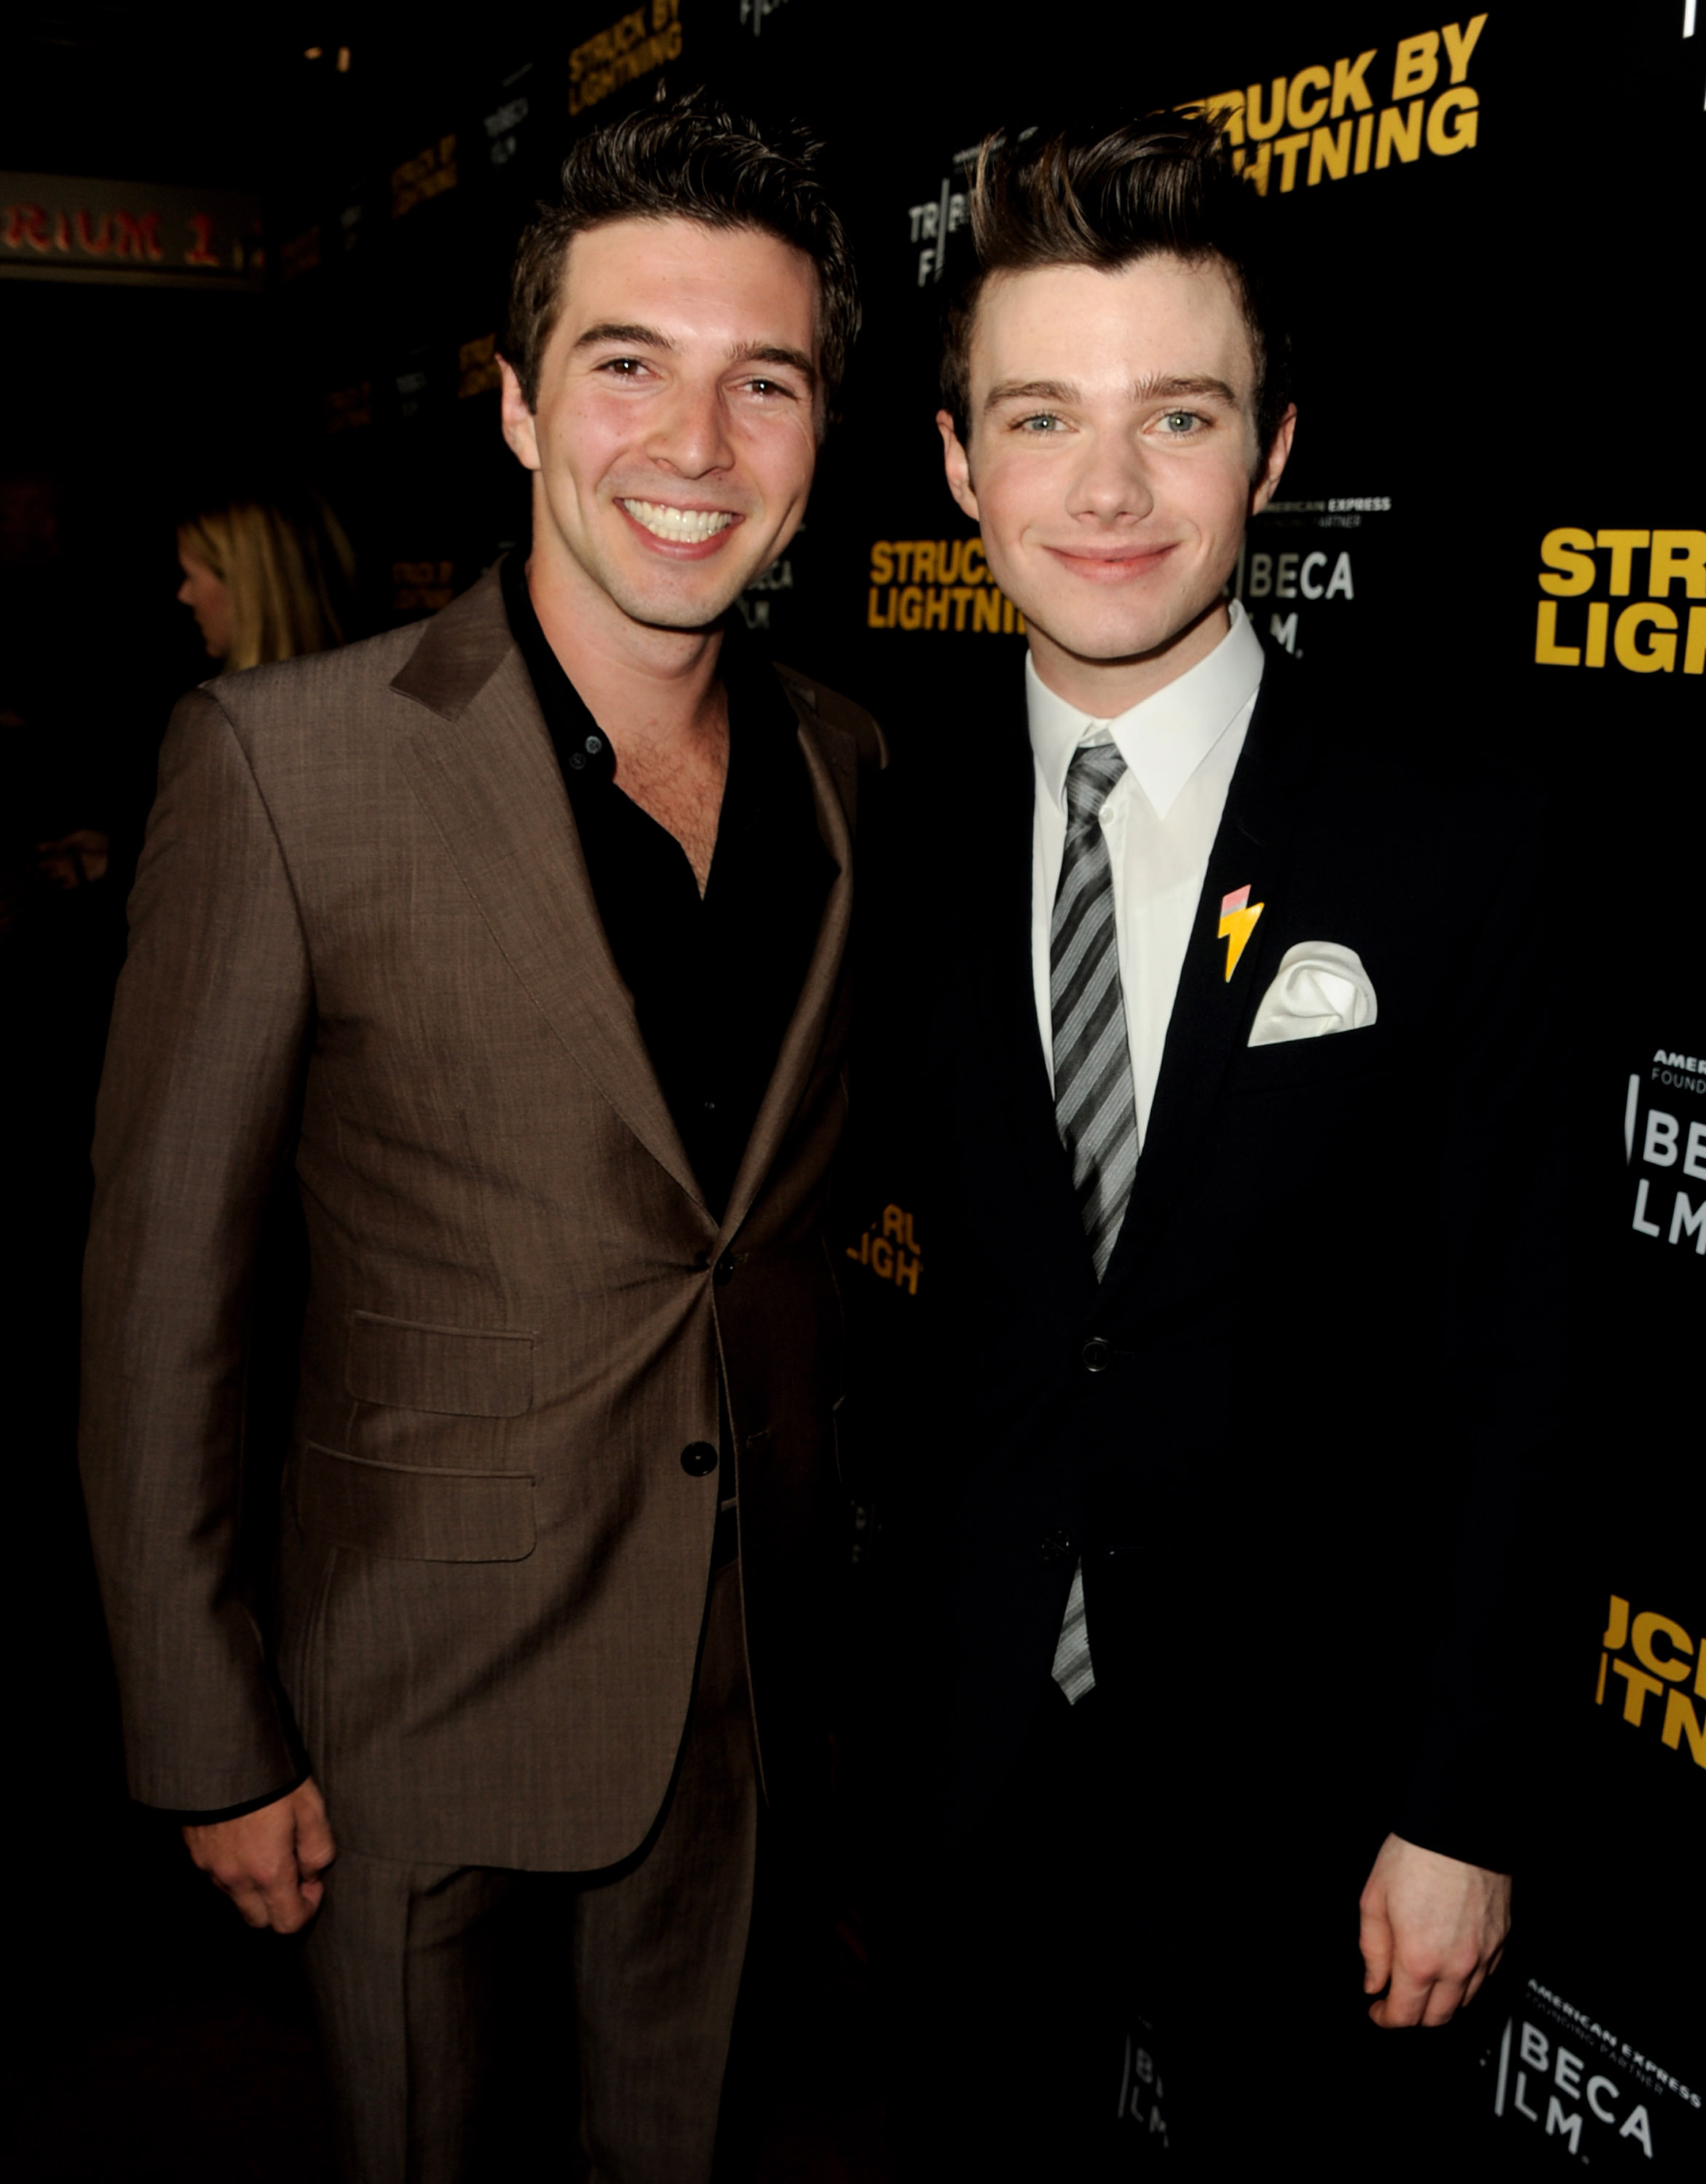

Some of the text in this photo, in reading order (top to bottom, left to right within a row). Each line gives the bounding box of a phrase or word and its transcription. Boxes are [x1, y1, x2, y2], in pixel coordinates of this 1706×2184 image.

[1172, 12, 1490, 148] RUCK BY
[1327, 496, 1392, 513] EXPRESS
[869, 537, 995, 587] STRUC
[1527, 1977, 1702, 2110] AMERICAN EXPRESS
